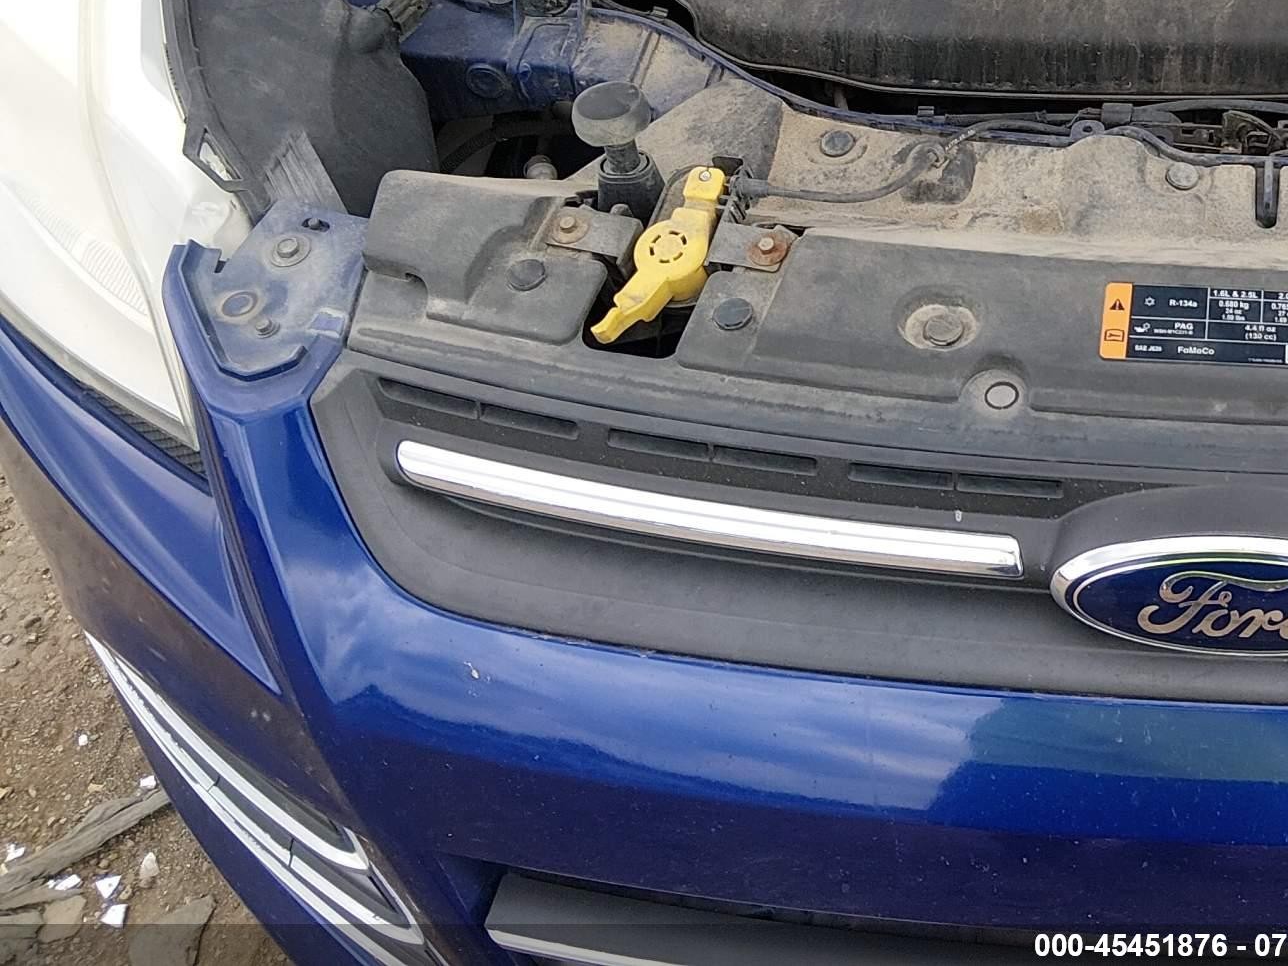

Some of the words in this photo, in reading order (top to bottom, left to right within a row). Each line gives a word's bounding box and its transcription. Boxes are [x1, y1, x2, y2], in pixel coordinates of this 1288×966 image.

[1169, 298, 1198, 308] R-134a
[1239, 301, 1250, 310] kg
[1174, 321, 1194, 330] PAG
[1245, 332, 1263, 340] (130
[1264, 333, 1277, 341] cc)
[1177, 345, 1215, 355] FoMoCo
